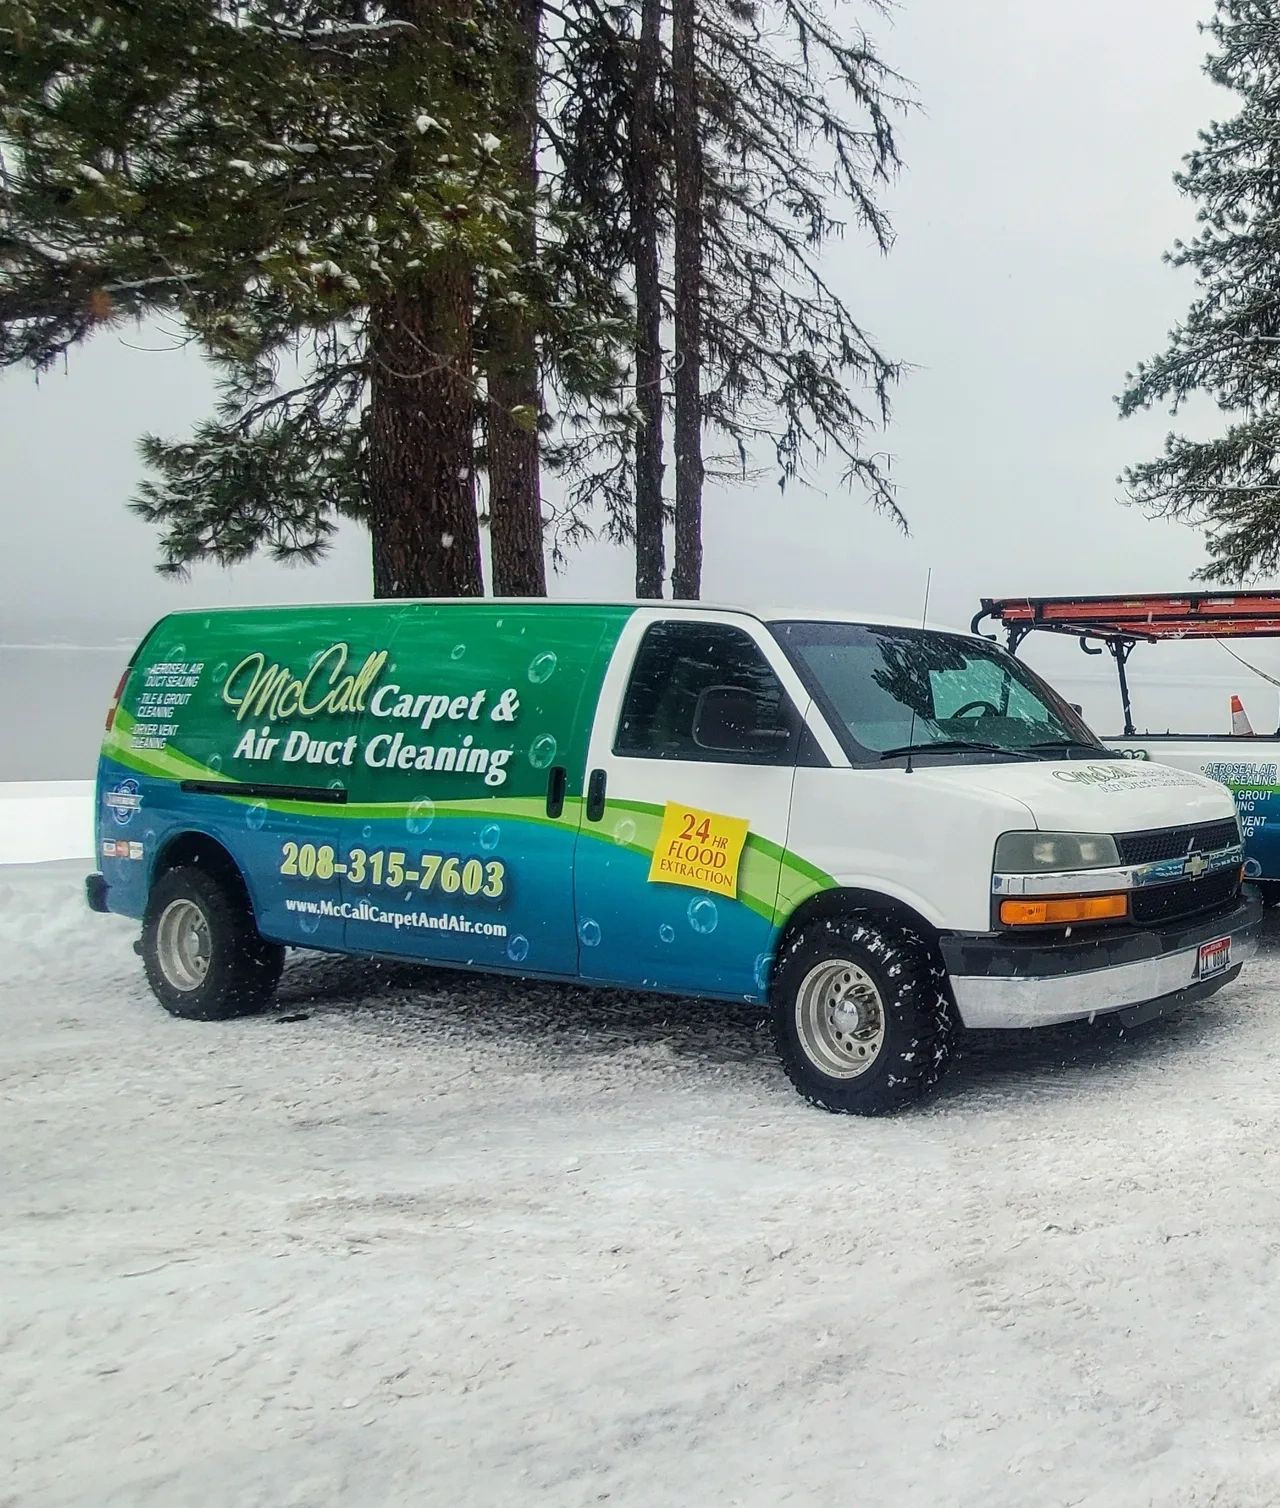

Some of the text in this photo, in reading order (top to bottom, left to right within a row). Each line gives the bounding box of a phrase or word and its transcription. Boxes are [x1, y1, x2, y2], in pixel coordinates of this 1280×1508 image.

[149, 663, 204, 675] AEROSEAL AIR
[144, 676, 199, 687] DUCT SEALING
[222, 642, 520, 730] McCall Carpet &
[141, 693, 157, 705] TILE
[164, 693, 192, 705] GROUT
[137, 706, 174, 718] CLEANING
[159, 724, 180, 736] VENT
[232, 726, 514, 787] Air Duct Cleaning
[1205, 763, 1277, 775] AEROSEAL AIR
[1234, 774, 1276, 786] SEALING
[1238, 790, 1273, 800] GROUT
[1241, 816, 1267, 826] VENT
[679, 814, 729, 849] 24 HR
[668, 840, 726, 868] FLOOD
[280, 841, 506, 898] 208-315-7603
[660, 858, 733, 887] EXTRACTION
[286, 898, 508, 937] www.McCallCarpetAndAir.com
